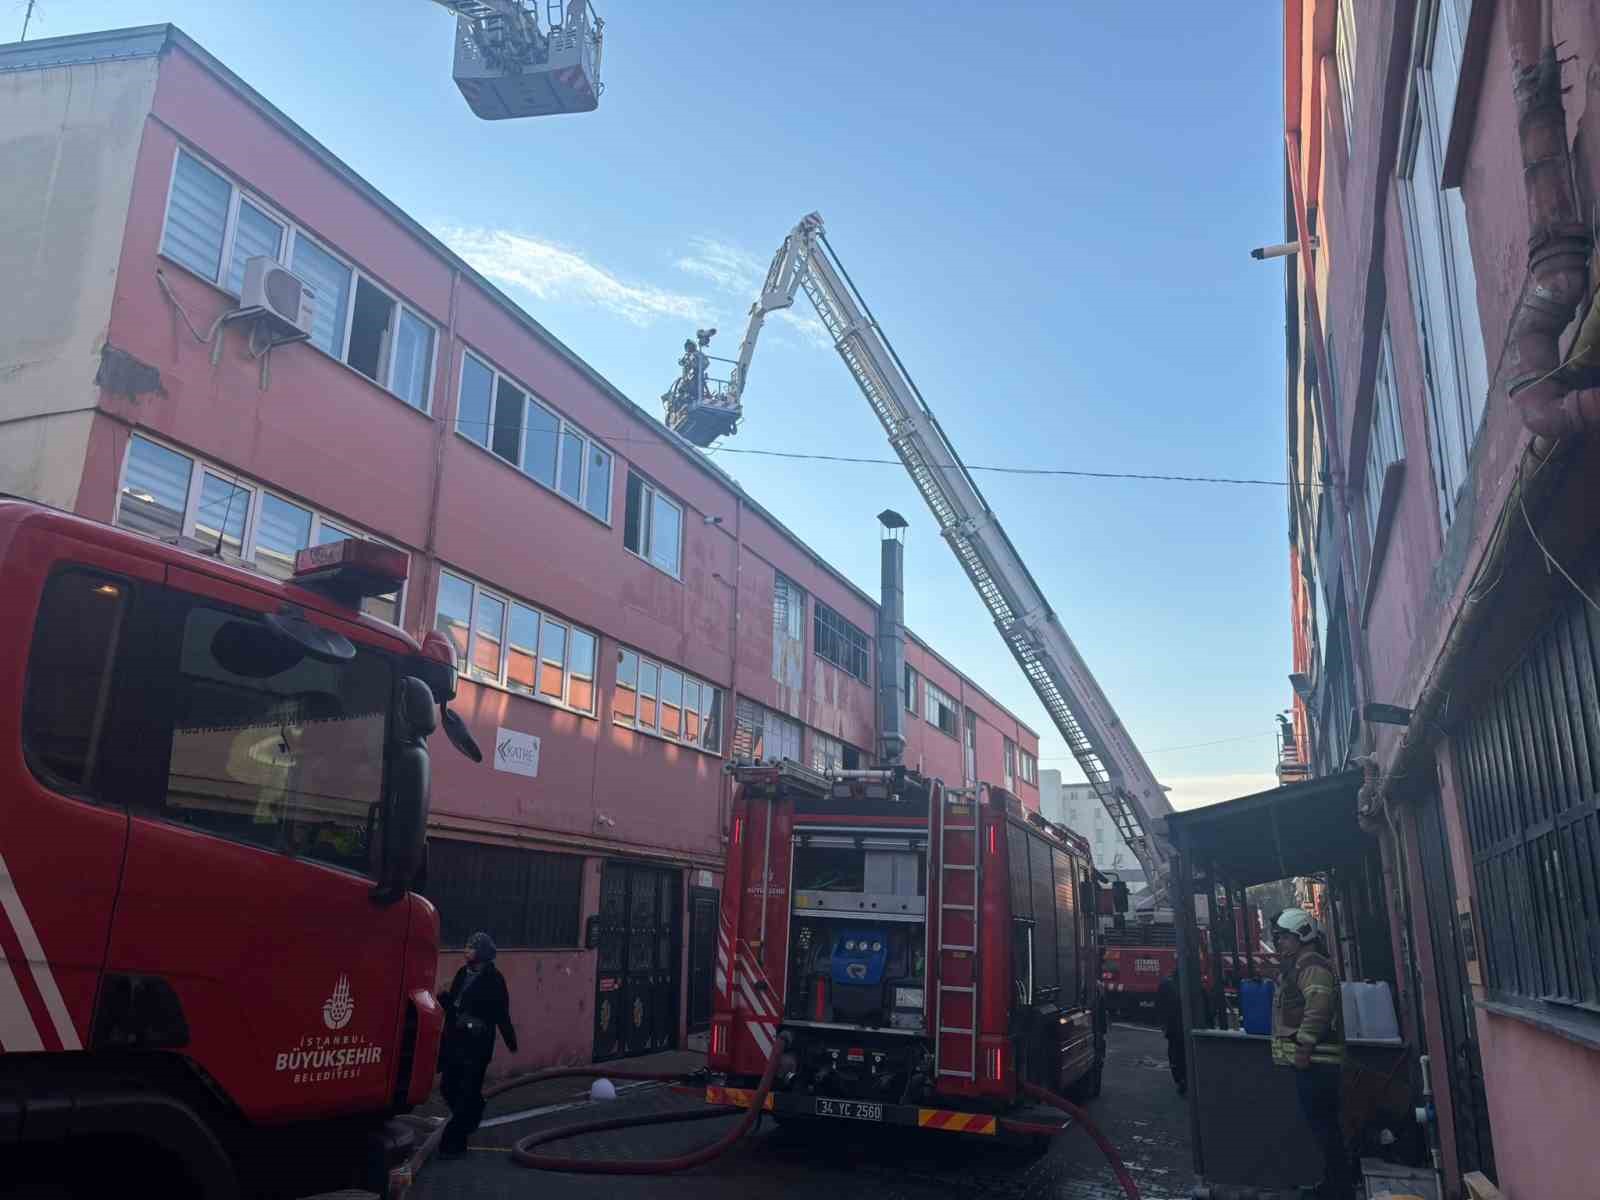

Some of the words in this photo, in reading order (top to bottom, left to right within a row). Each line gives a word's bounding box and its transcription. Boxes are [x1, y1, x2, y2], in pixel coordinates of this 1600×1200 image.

[275, 1042, 382, 1072] BÜYÜKŞEHİR
[821, 1101, 833, 1113] 34
[839, 1102, 851, 1115] YC
